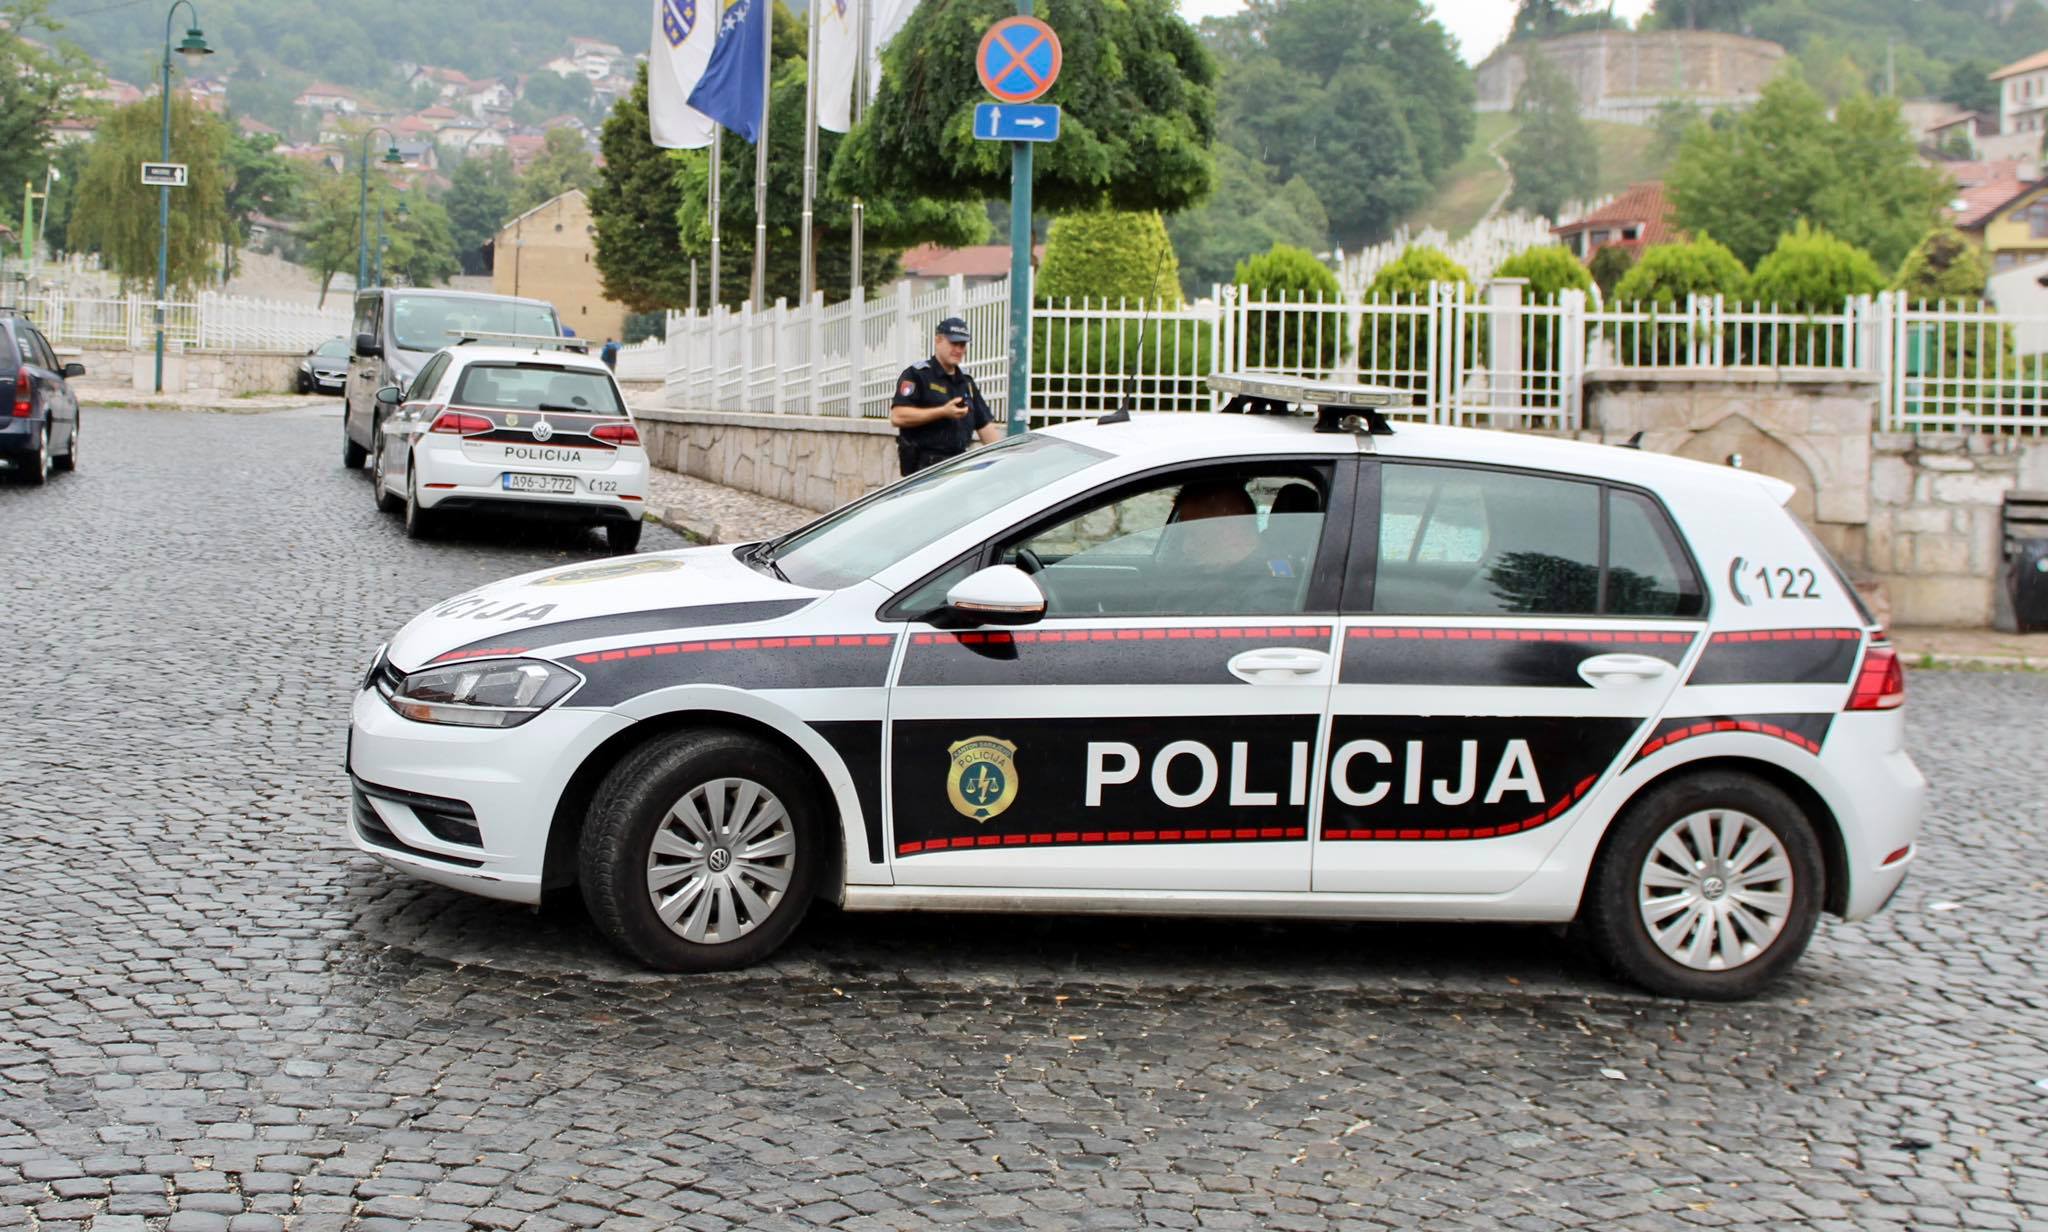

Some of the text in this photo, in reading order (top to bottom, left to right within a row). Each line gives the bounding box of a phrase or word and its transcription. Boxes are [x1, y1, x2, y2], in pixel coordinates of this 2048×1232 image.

[505, 447, 581, 462] POLICIJA
[512, 475, 572, 490] A96-J-772
[598, 481, 617, 492] 122
[1755, 566, 1822, 599] 122
[958, 751, 1006, 768] POLICIJA
[1085, 739, 1546, 808] POLICIJA
